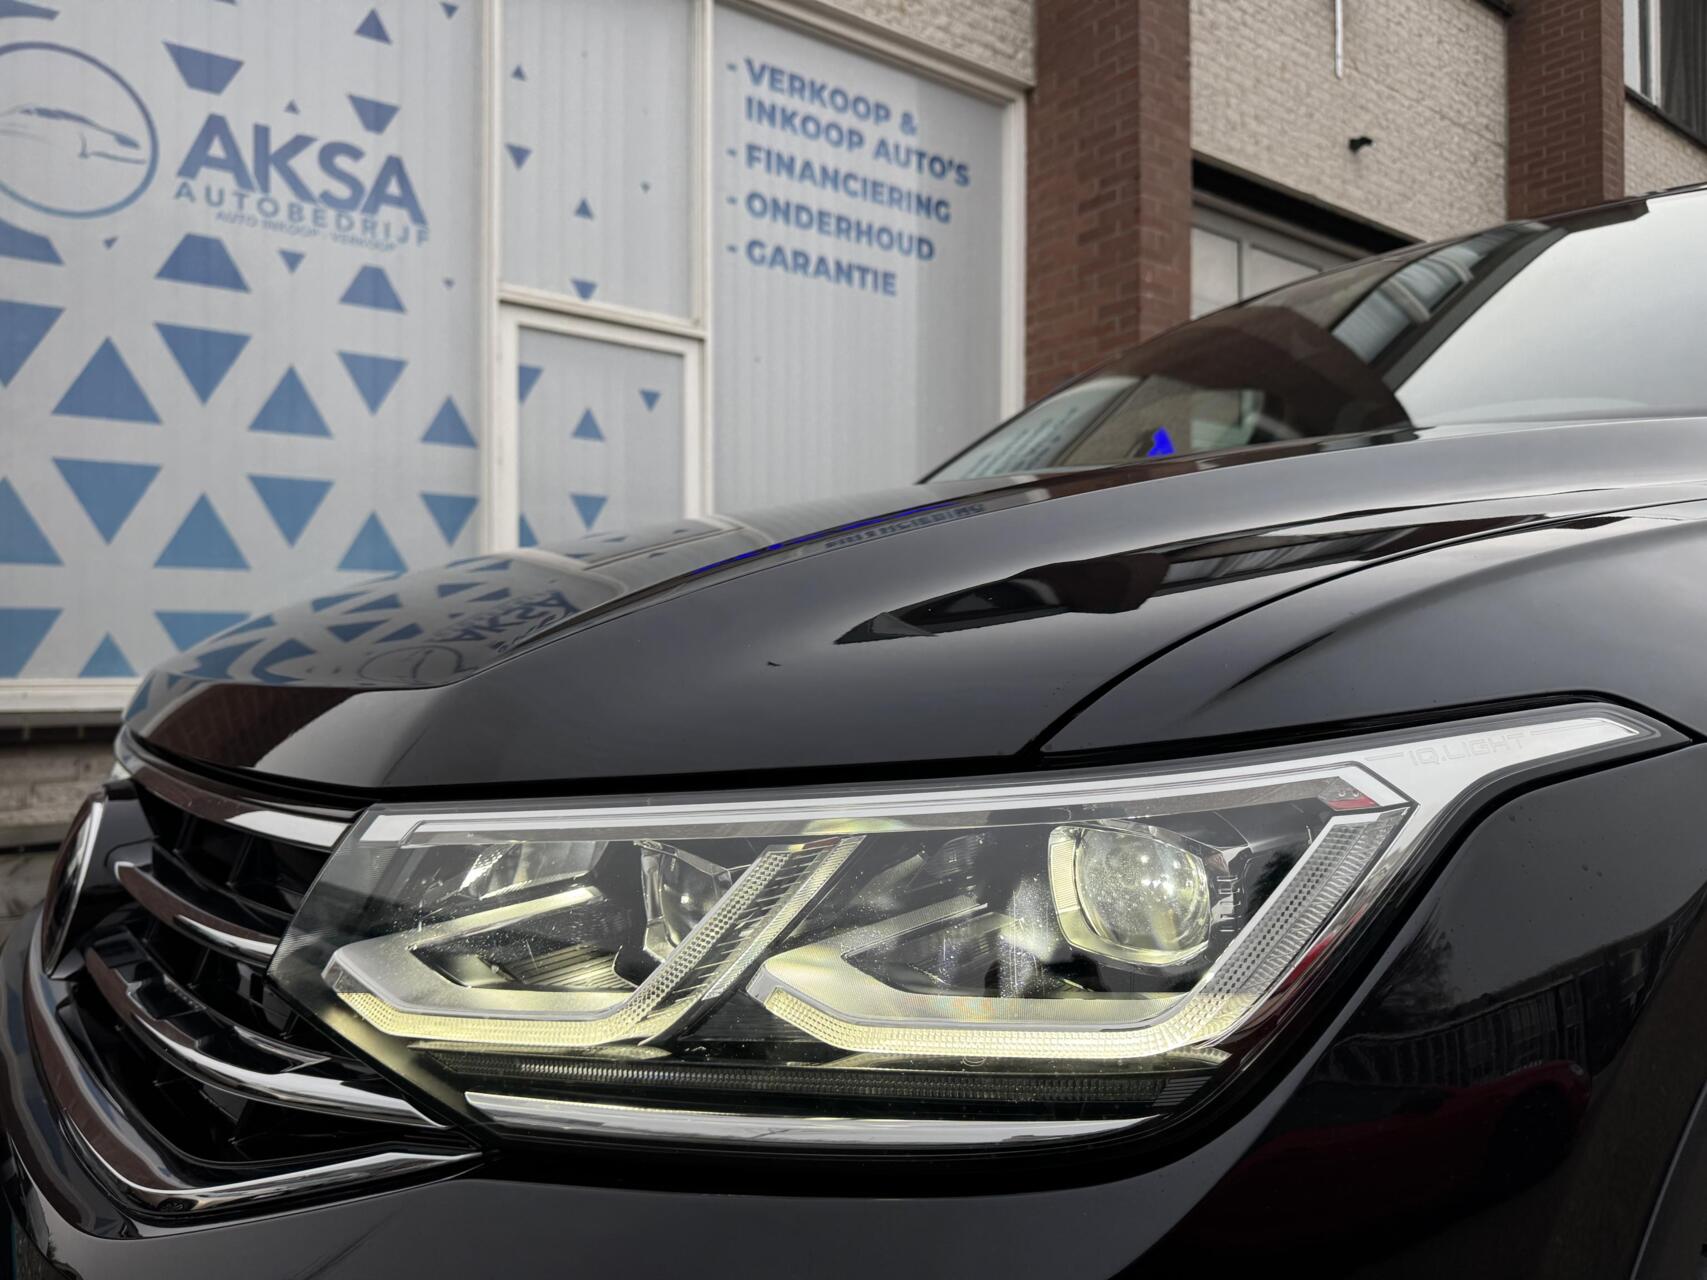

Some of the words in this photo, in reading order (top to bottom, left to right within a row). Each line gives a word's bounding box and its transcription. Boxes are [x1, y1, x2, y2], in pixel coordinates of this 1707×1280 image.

[744, 56, 891, 125] VERKOOP
[900, 111, 917, 136] &
[177, 112, 428, 227] AKSA
[745, 96, 864, 152] INKOOP
[873, 137, 970, 187] AUTO'S
[174, 181, 430, 246] AUTOBEDRIJF
[745, 143, 951, 224] FINANCIERING
[744, 191, 935, 261] ONDERHOUD
[744, 239, 898, 296] GARANTIE
